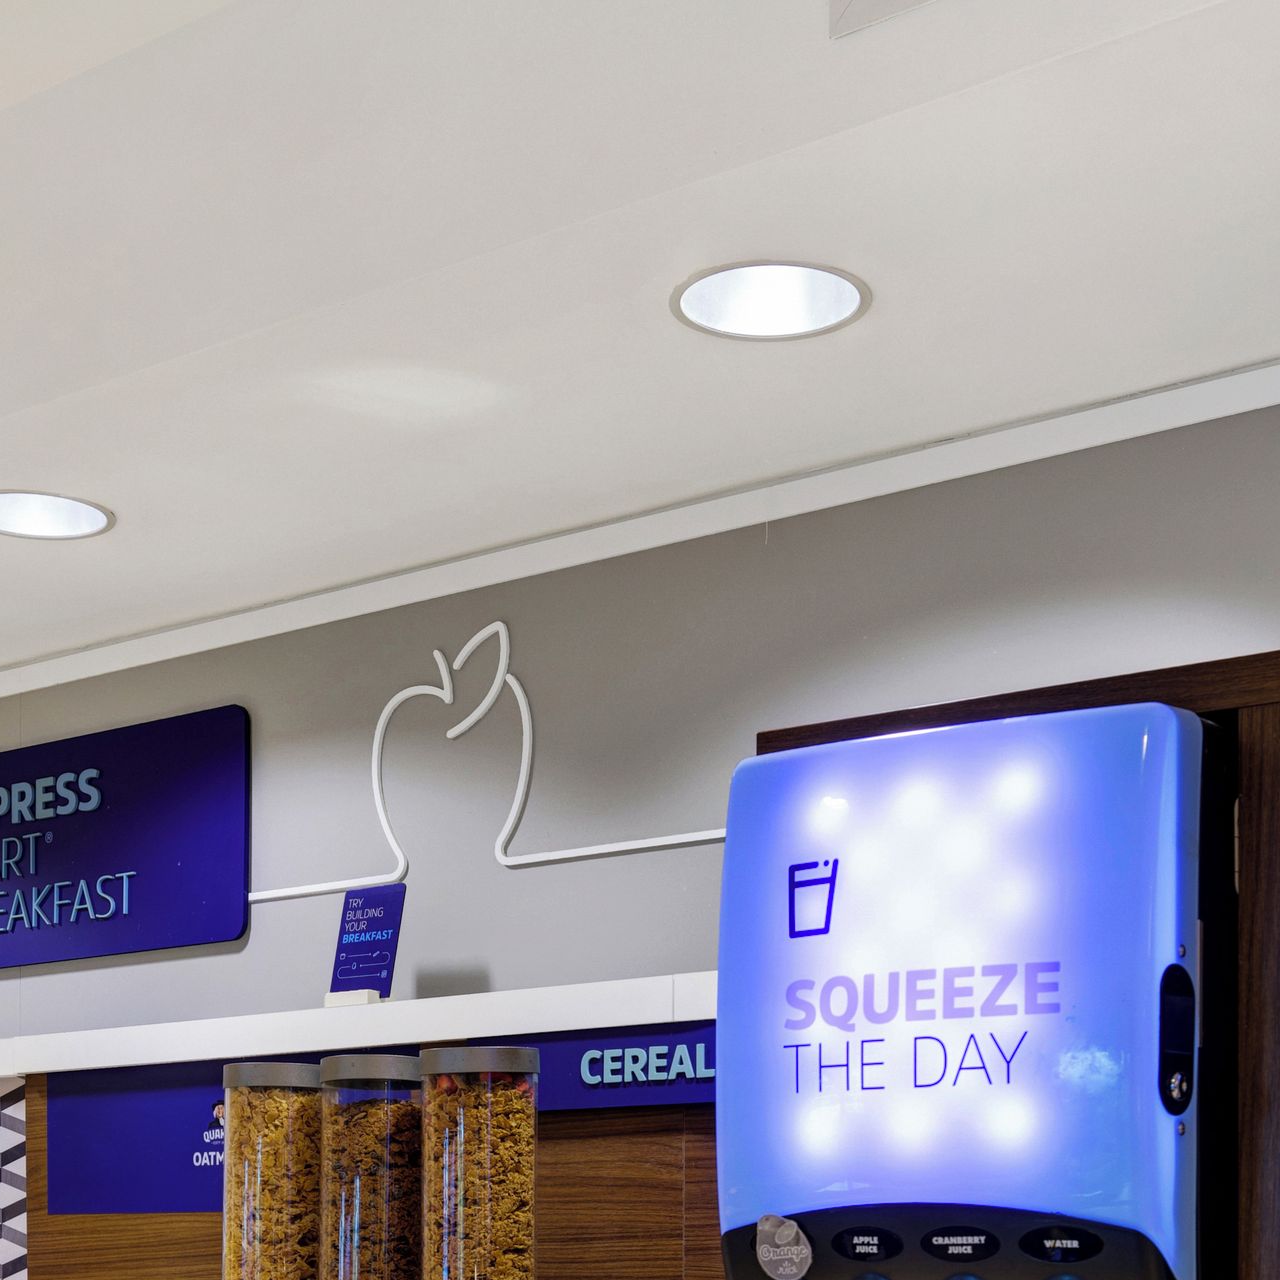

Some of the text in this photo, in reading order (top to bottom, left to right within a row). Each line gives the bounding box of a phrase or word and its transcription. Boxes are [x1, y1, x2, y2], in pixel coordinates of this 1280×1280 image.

[348, 897, 365, 909] TRY
[346, 907, 384, 921] BUILDING
[344, 920, 368, 932] YOUR
[342, 929, 394, 944] BREAKFAST
[783, 961, 1061, 1032] SQUEEZE
[580, 1043, 716, 1085] CEREAL
[783, 1031, 1028, 1094] THE DAY
[203, 1129, 224, 1143] QUAK
[193, 1151, 225, 1166] OATM
[852, 1236, 879, 1245] APPLE
[932, 1236, 986, 1246] CRANBERRY
[1044, 1238, 1080, 1249] WATER
[760, 1244, 809, 1263] Orange
[855, 1245, 878, 1254] JUICE
[948, 1245, 973, 1254] JUICE
